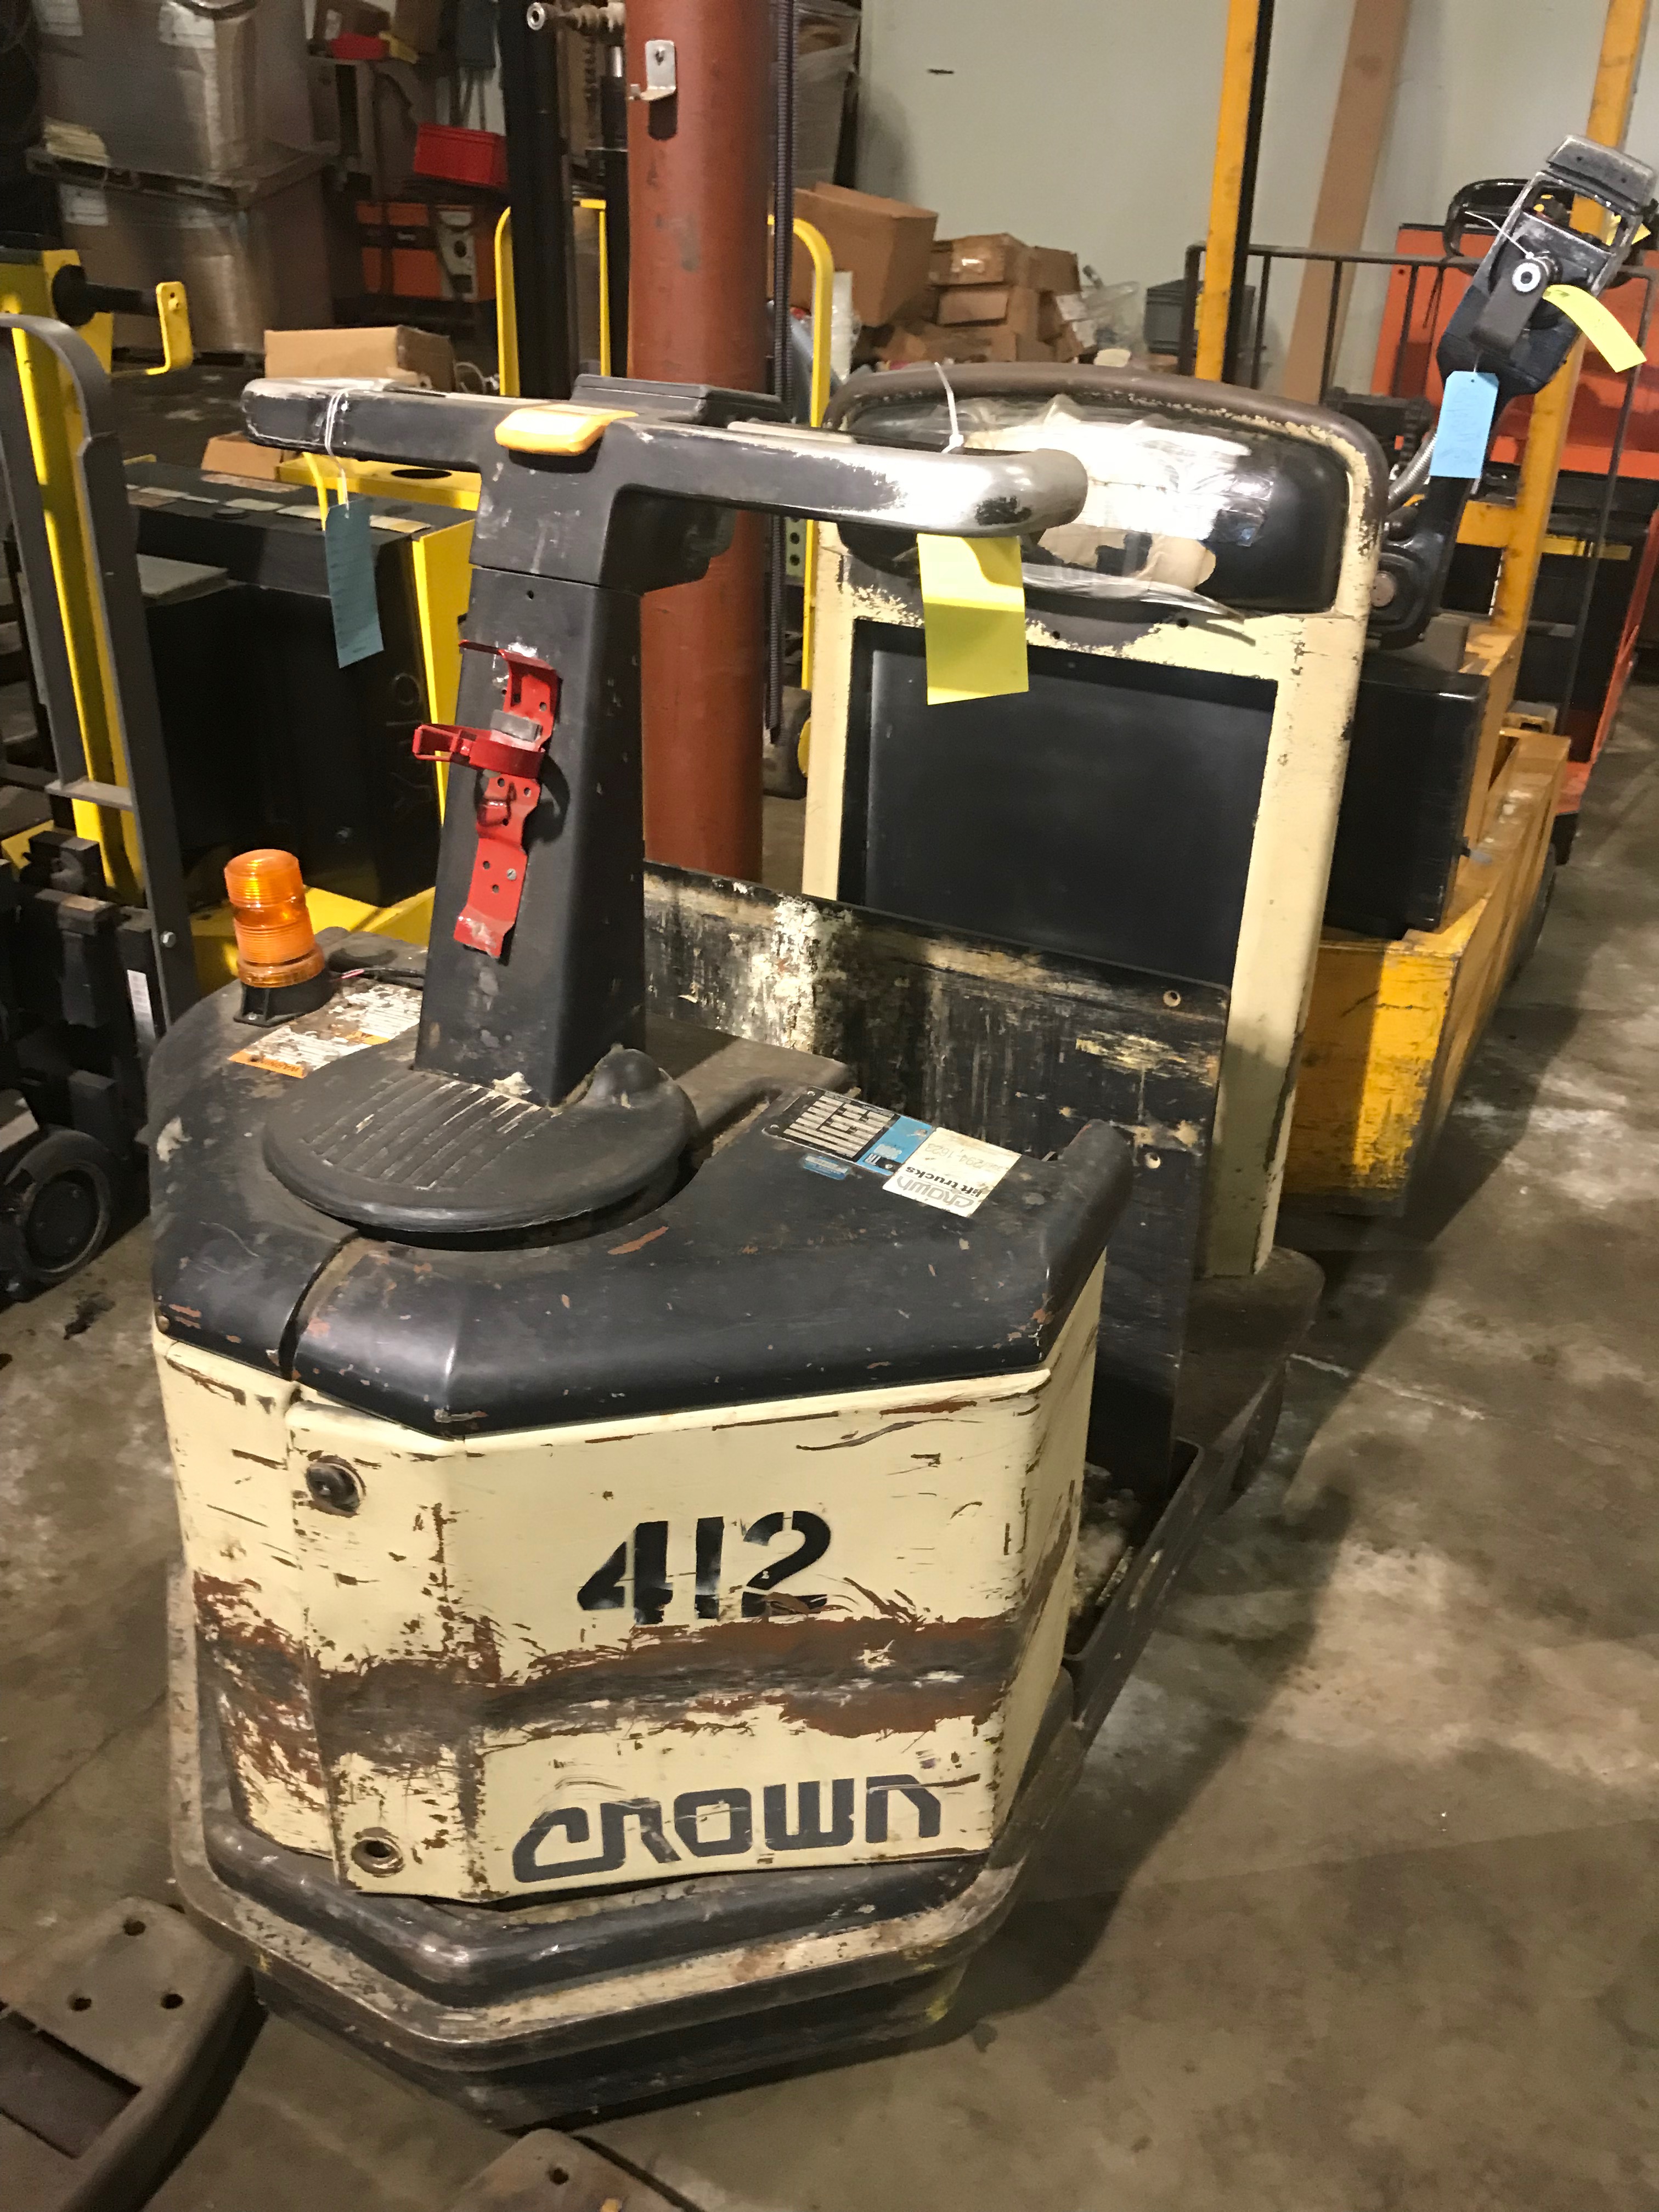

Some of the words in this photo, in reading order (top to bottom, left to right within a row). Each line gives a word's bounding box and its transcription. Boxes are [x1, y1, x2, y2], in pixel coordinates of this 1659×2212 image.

[906, 1166, 958, 1190] trucks
[960, 1184, 983, 1198] lift
[577, 1510, 831, 1625] 412
[512, 1774, 941, 1883] CROWN
